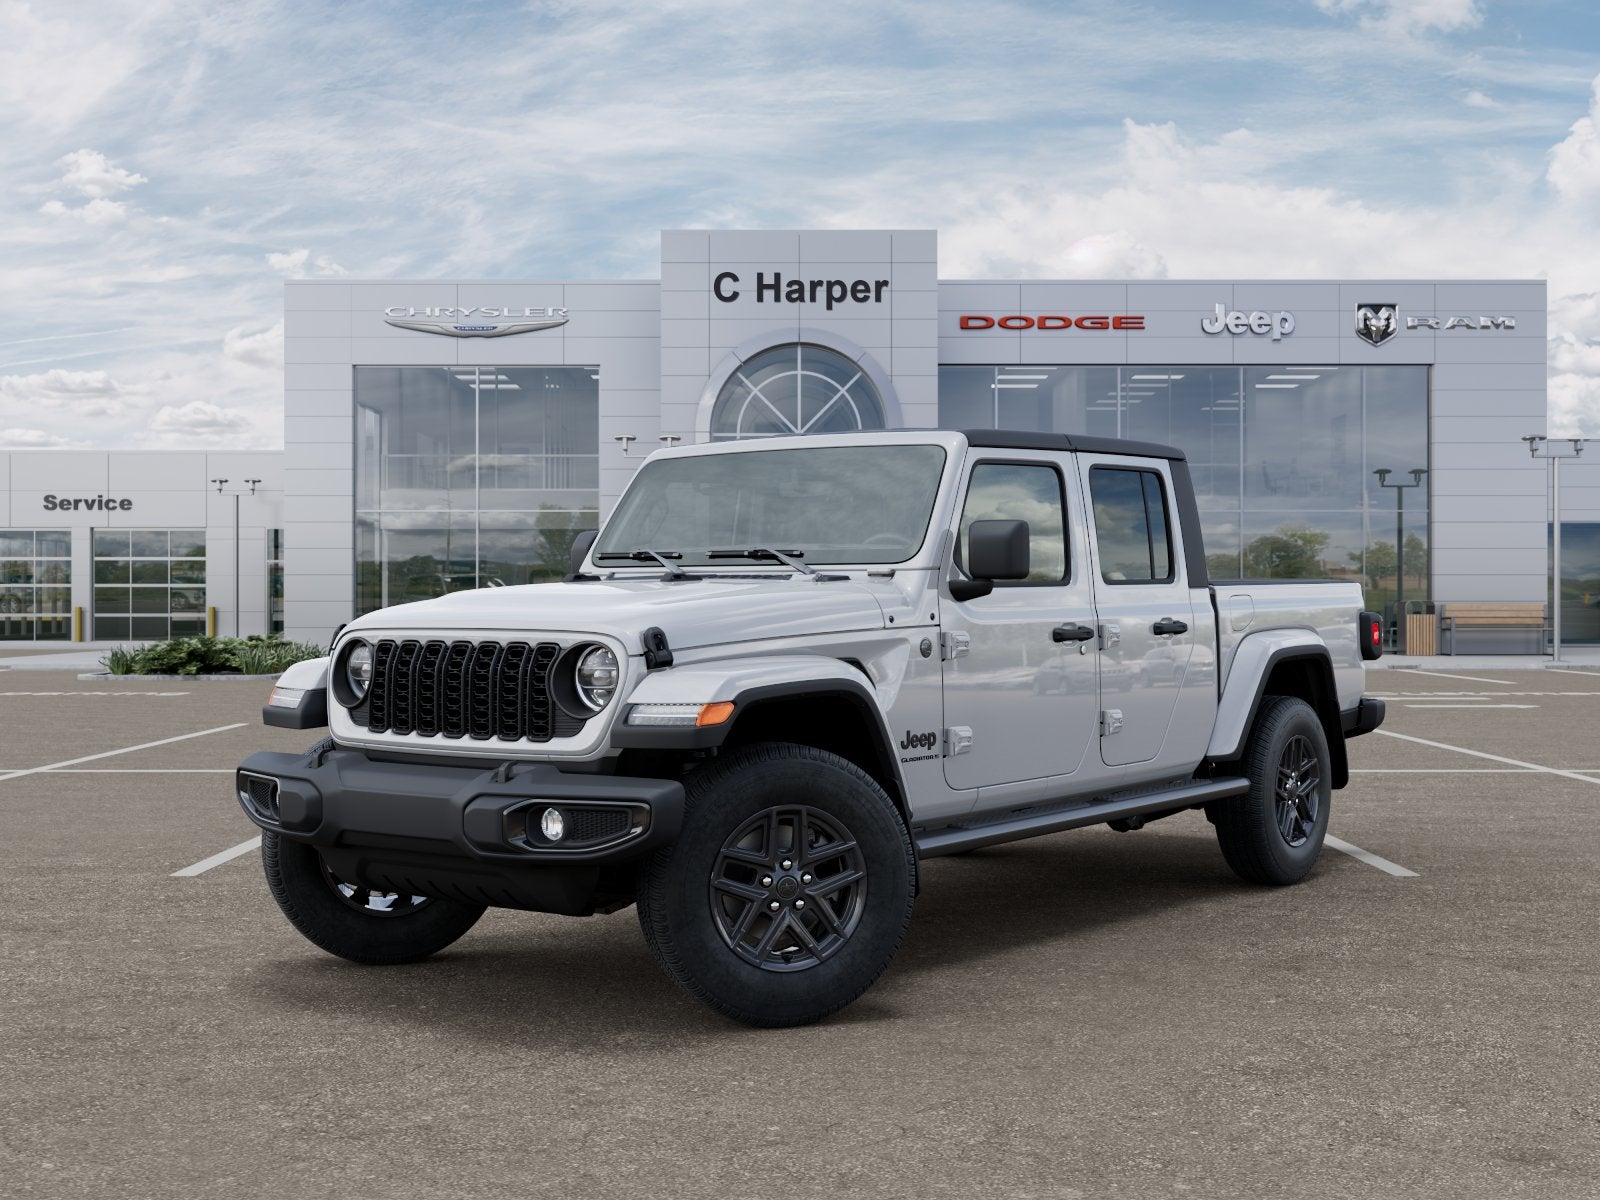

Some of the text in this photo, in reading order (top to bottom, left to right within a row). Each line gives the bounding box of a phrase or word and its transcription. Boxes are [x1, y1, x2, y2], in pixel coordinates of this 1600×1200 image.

[713, 271, 889, 311] C Harper
[384, 306, 568, 317] CHRYSLER
[959, 315, 1146, 330] DODGE
[1201, 302, 1296, 342] Jeep
[1406, 316, 1516, 330] RAM
[43, 494, 133, 511] Service
[900, 730, 937, 751] Jeep
[900, 754, 934, 763] GLADIATOR
